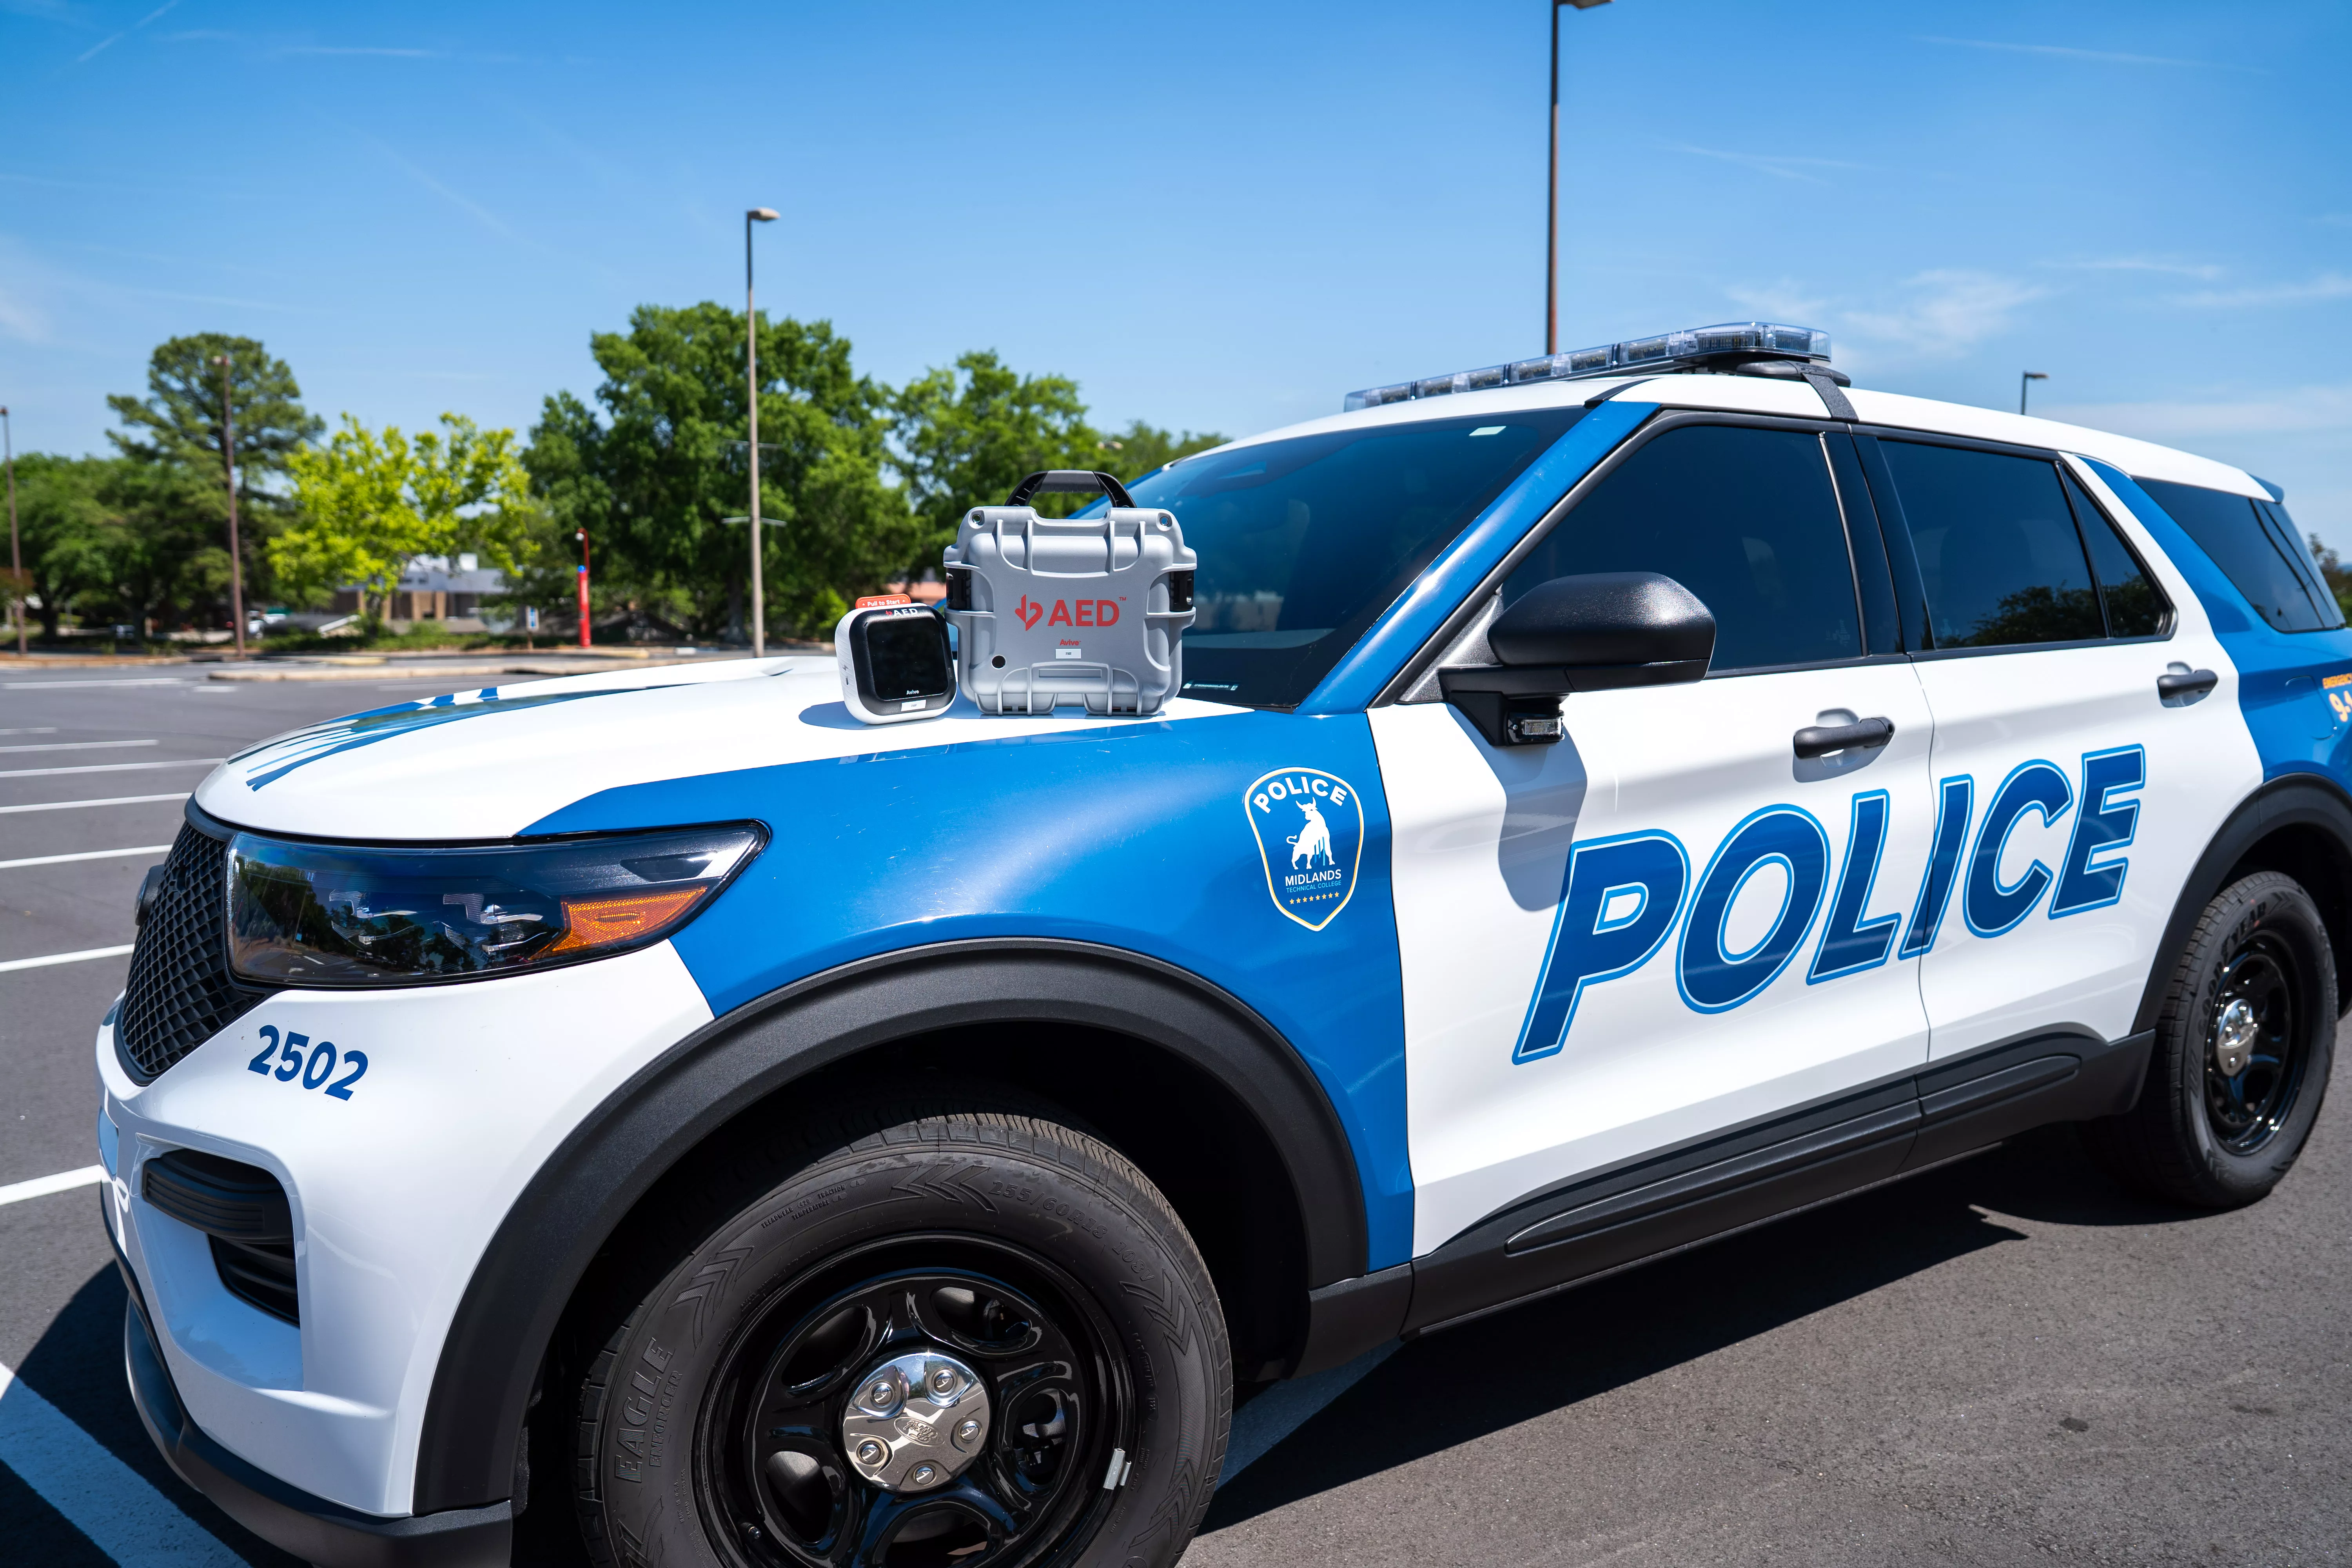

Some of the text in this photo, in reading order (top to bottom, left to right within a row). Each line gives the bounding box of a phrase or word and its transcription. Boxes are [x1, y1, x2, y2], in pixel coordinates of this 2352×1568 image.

[893, 608, 918, 617] AED
[1047, 599, 1120, 626] AED
[1253, 776, 1348, 814] POLICE
[1285, 869, 1341, 886] MIDLANDS
[1286, 880, 1341, 893] TECHNICAL COLLEGE
[1511, 743, 2147, 1066] POLICE
[247, 1025, 368, 1101] 2502
[761, 1206, 793, 1229] TREADWEAR
[817, 1185, 845, 1199] TRACTION
[791, 1200, 830, 1220] TEMPERATURE
[988, 1180, 1156, 1282] 255/60R18 108V
[615, 1337, 673, 1483] EAGLE
[649, 1370, 683, 1467] ENFORCER
[903, 1420, 938, 1443] Ford
